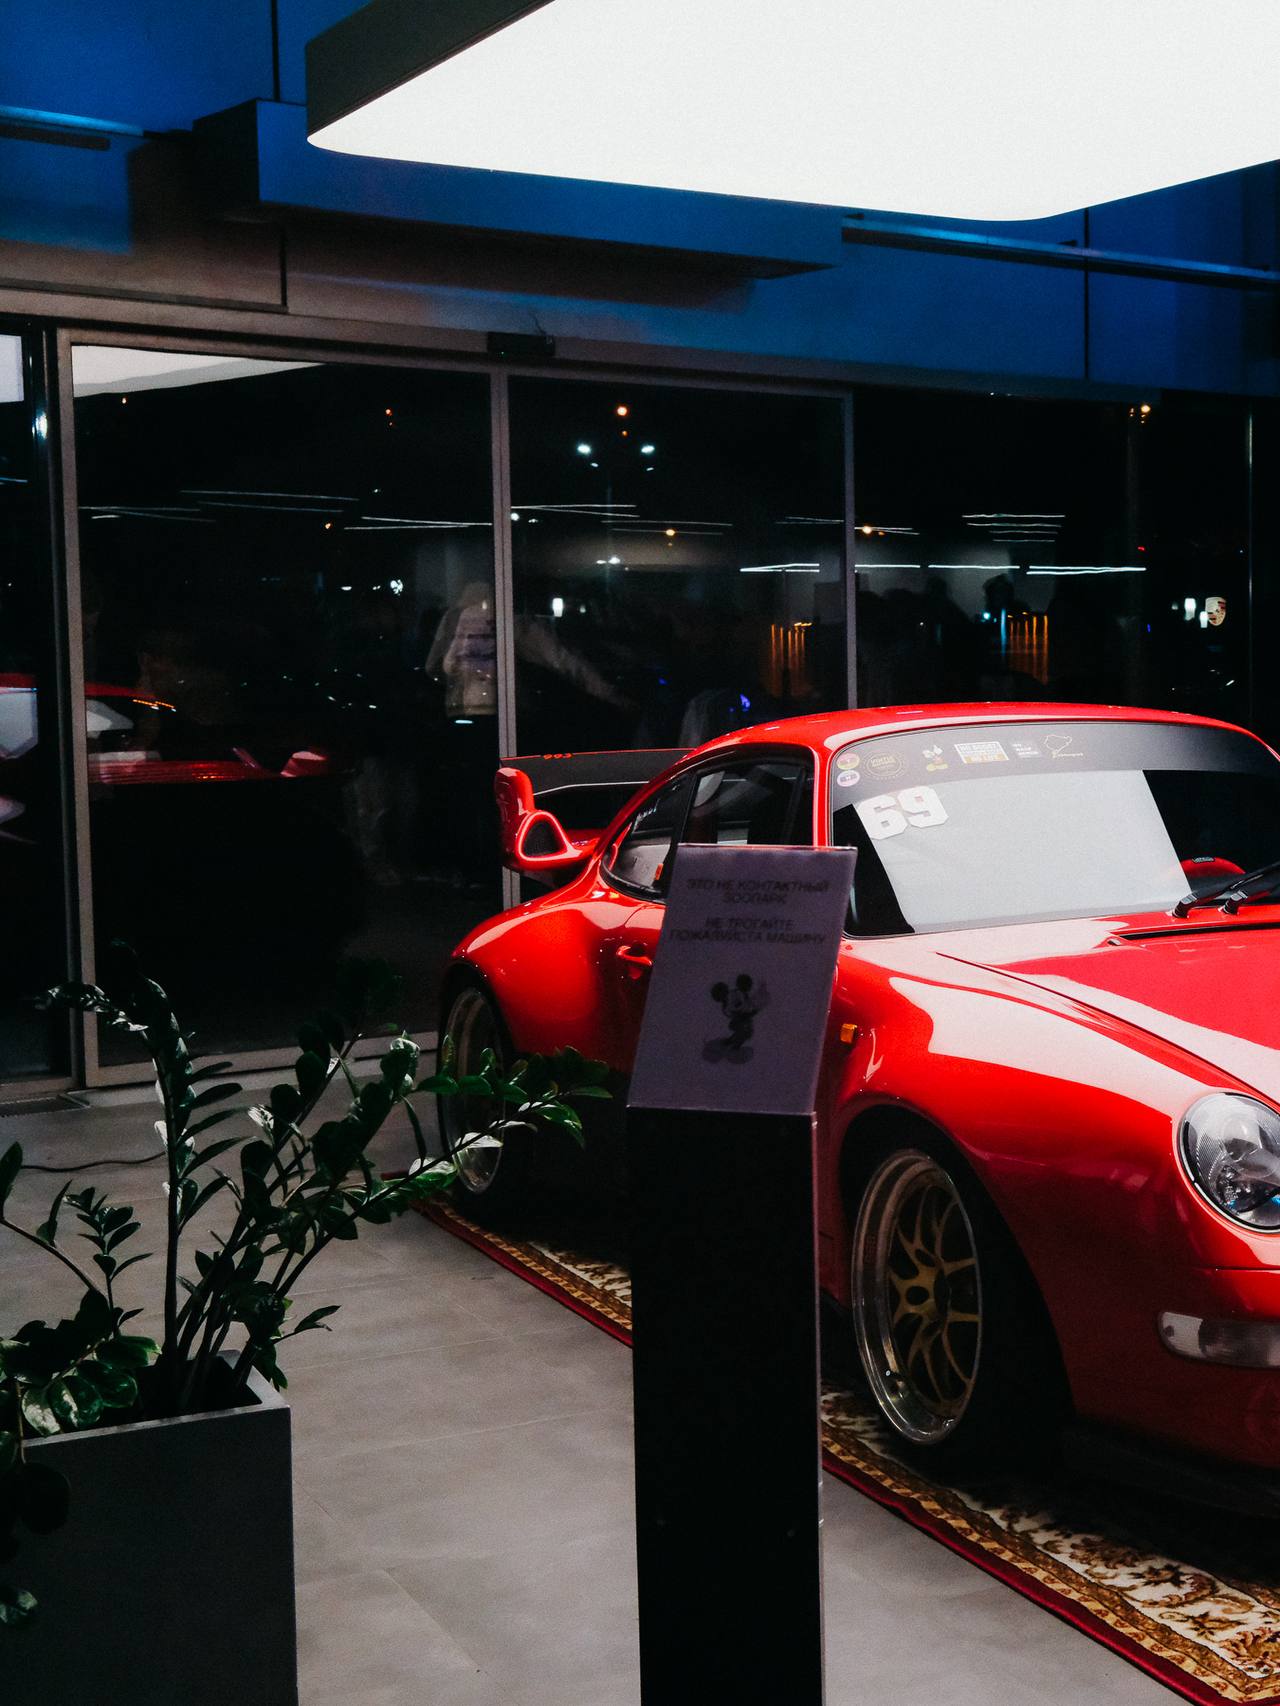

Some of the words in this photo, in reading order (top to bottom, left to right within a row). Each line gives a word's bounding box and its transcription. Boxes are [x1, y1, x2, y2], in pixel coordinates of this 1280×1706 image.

[856, 785, 949, 840] 69
[687, 879, 713, 890] ЭТО
[717, 879, 734, 891] НЕ
[705, 917, 723, 929] НЕ
